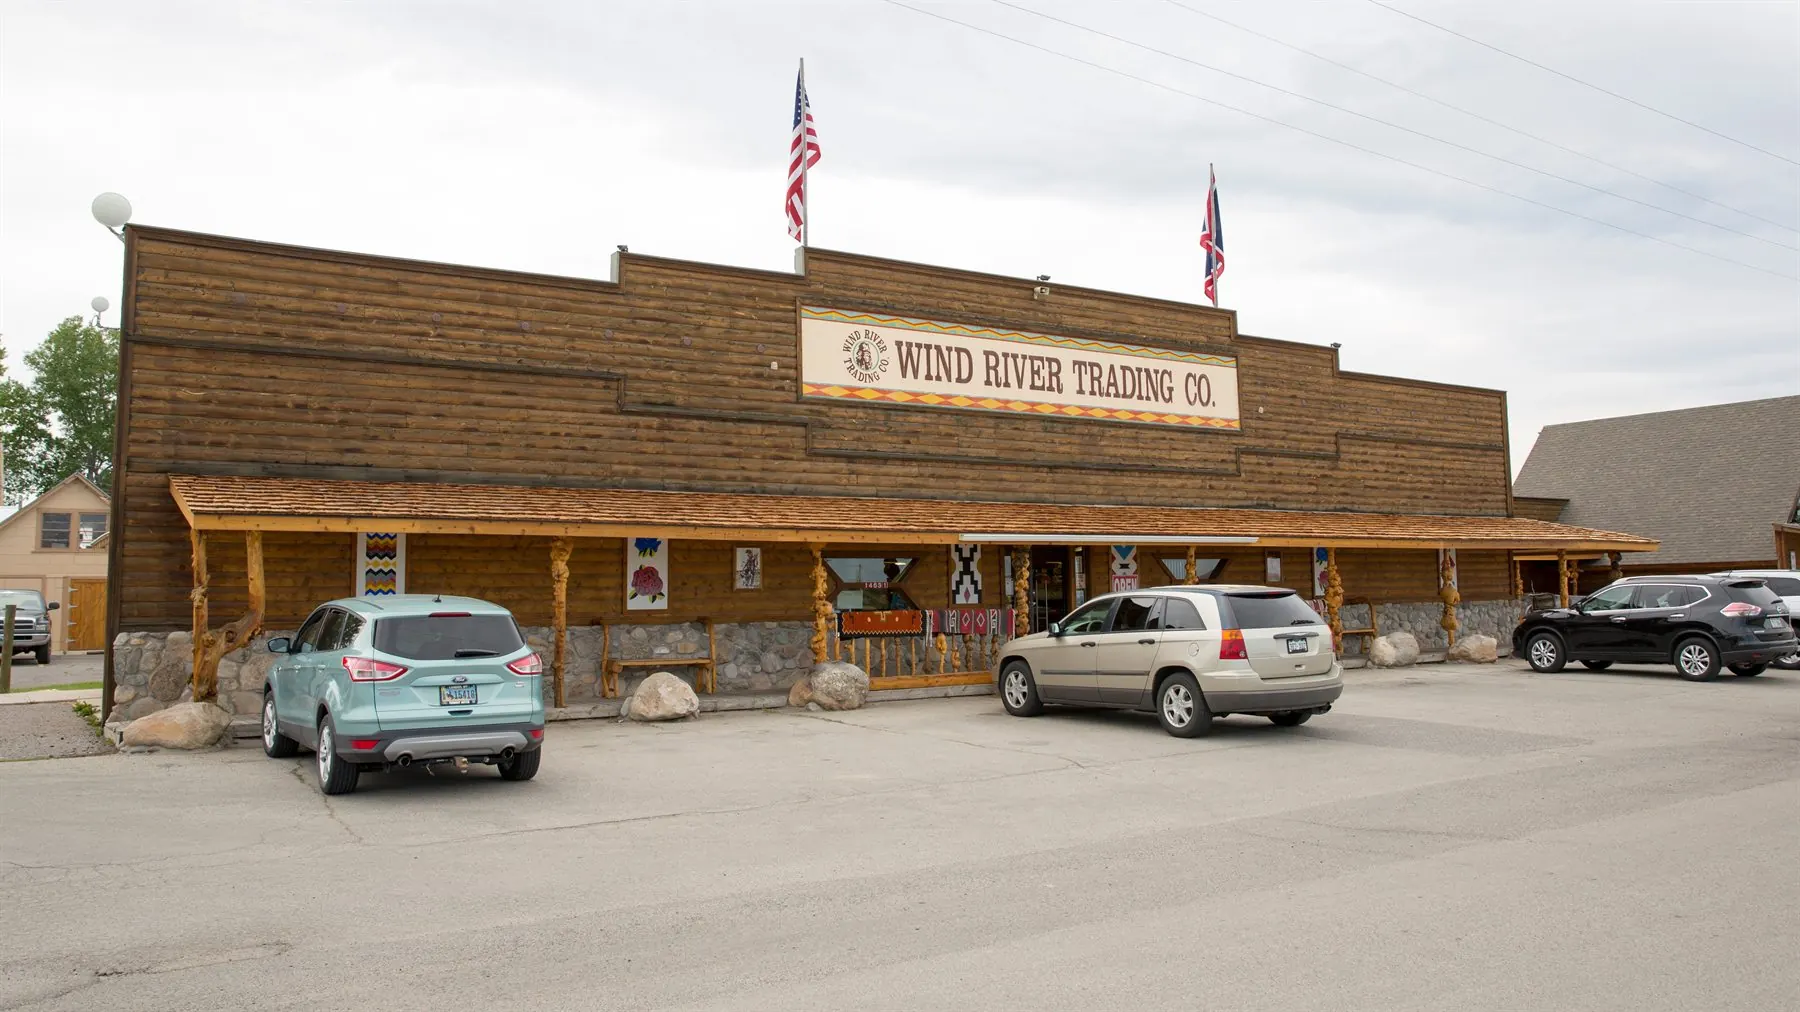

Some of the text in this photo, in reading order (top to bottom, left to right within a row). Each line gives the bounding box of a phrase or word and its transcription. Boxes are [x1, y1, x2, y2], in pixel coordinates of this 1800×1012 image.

[843, 329, 887, 353] WIND RIVER
[844, 357, 880, 383] TRADING
[895, 340, 1216, 408] WIND RIVER TRADING CO.
[1114, 578, 1137, 592] OPEN
